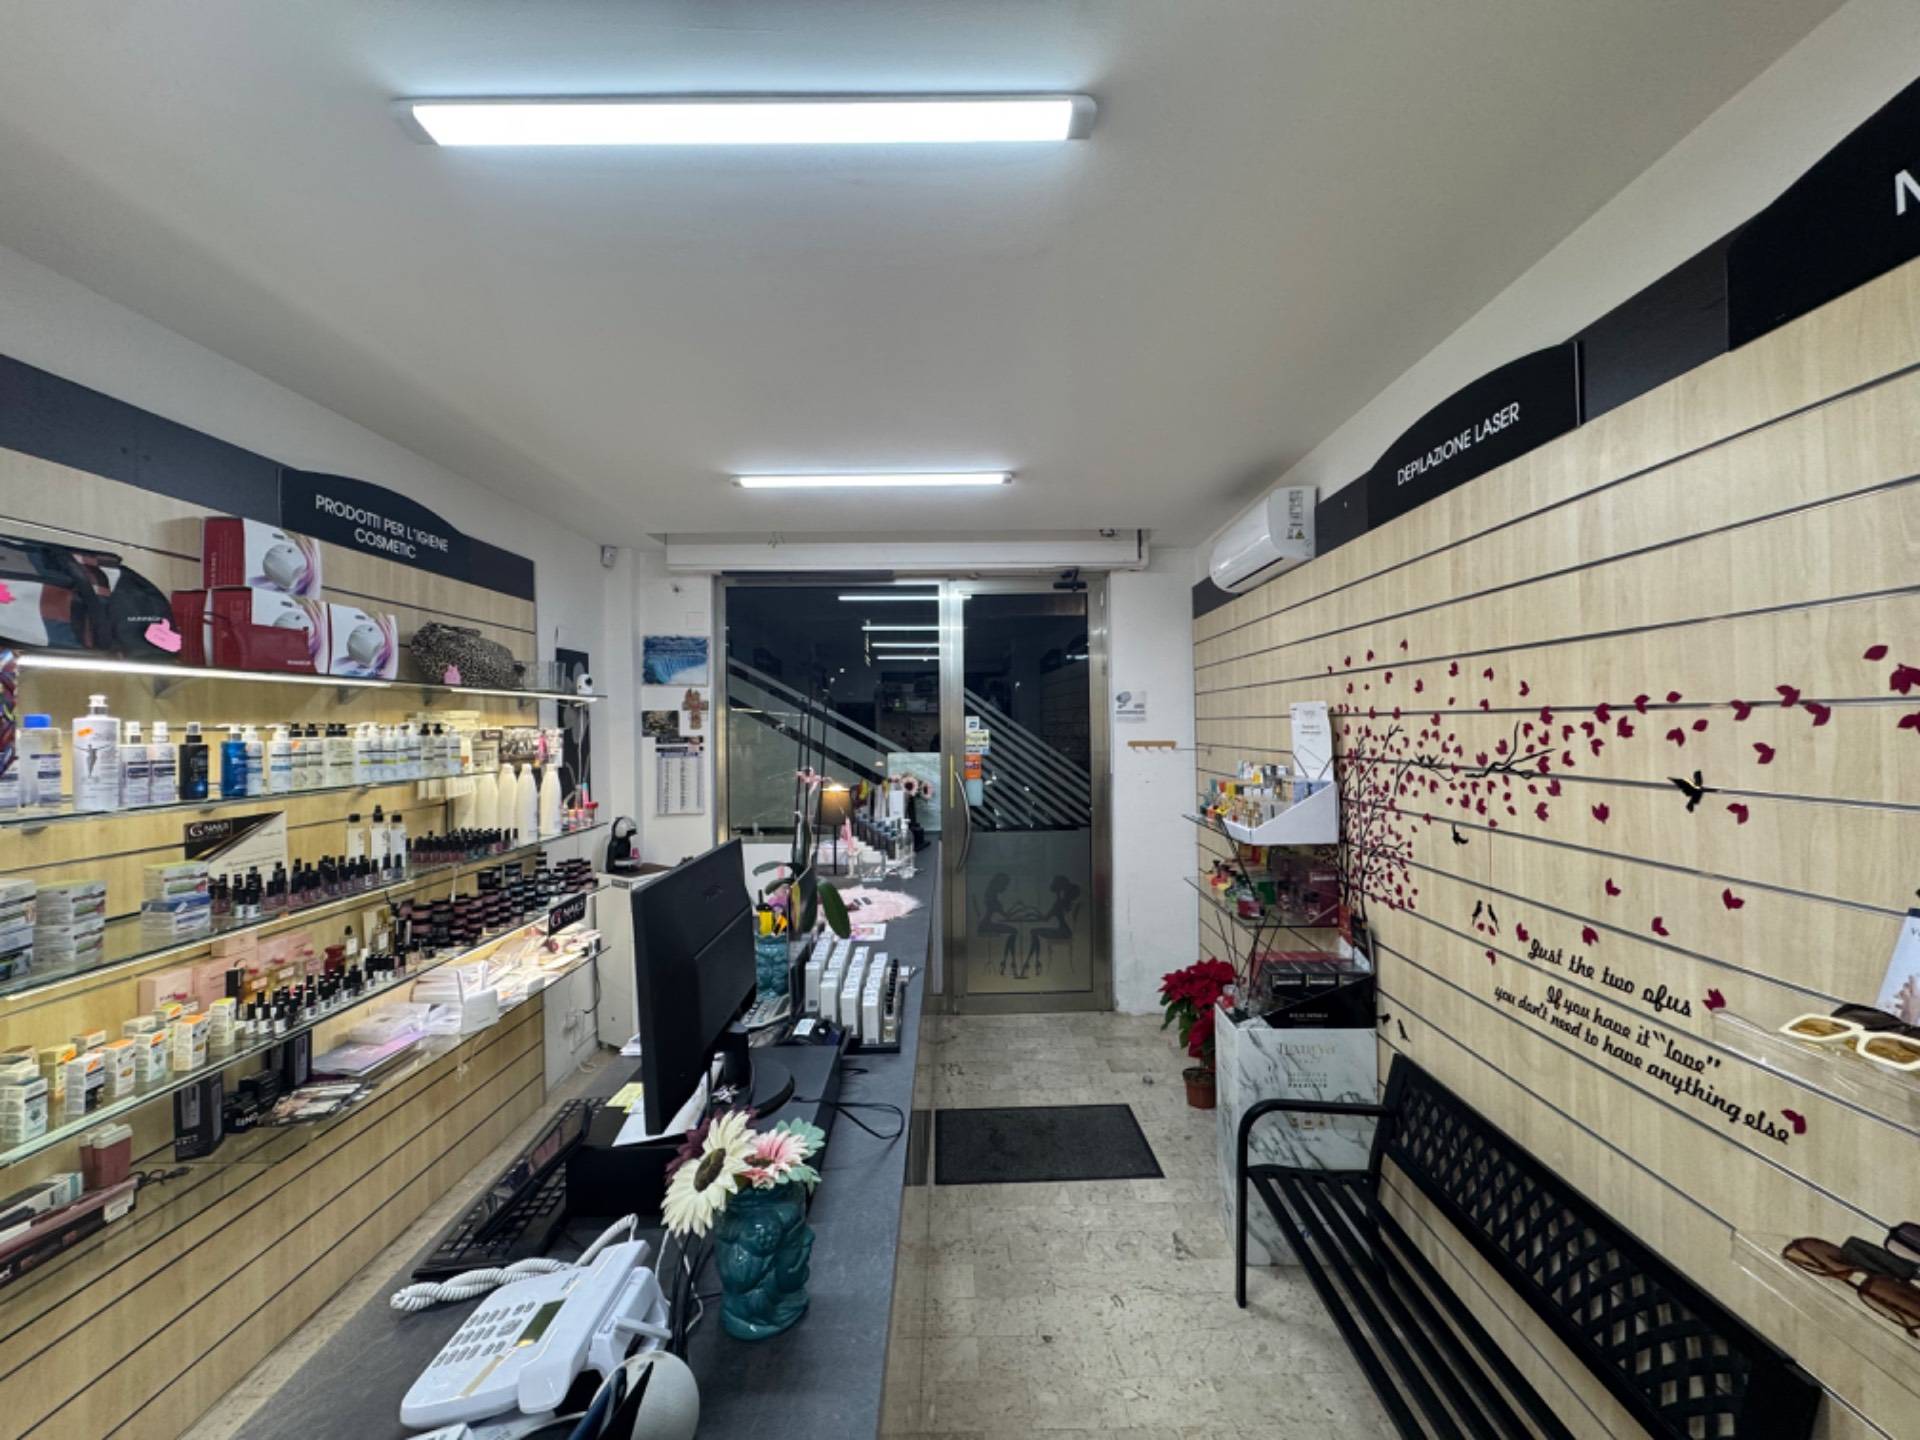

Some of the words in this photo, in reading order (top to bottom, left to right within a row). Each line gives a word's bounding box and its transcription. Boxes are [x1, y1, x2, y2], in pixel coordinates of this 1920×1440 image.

[1397, 428, 1472, 486] DEPILAZIONE
[1474, 402, 1521, 442] LASER
[316, 495, 380, 530] PRODOTTI
[383, 517, 405, 538] PER
[407, 525, 448, 553] L'IGIENE
[354, 527, 416, 559] COSMETIC
[1529, 938, 1563, 966] Just
[1567, 953, 1595, 980] the
[1600, 969, 1635, 995] two
[1545, 985, 1564, 1008] If
[1563, 994, 1591, 1018] you
[1594, 1006, 1631, 1037] have
[1494, 985, 1517, 1003] you
[1518, 991, 1549, 1021] don't
[1551, 1011, 1582, 1038] need
[1585, 1026, 1599, 1045] to
[1603, 1033, 1643, 1070] have
[1646, 1061, 1742, 1123] anything
[1743, 1112, 1790, 1145] else
